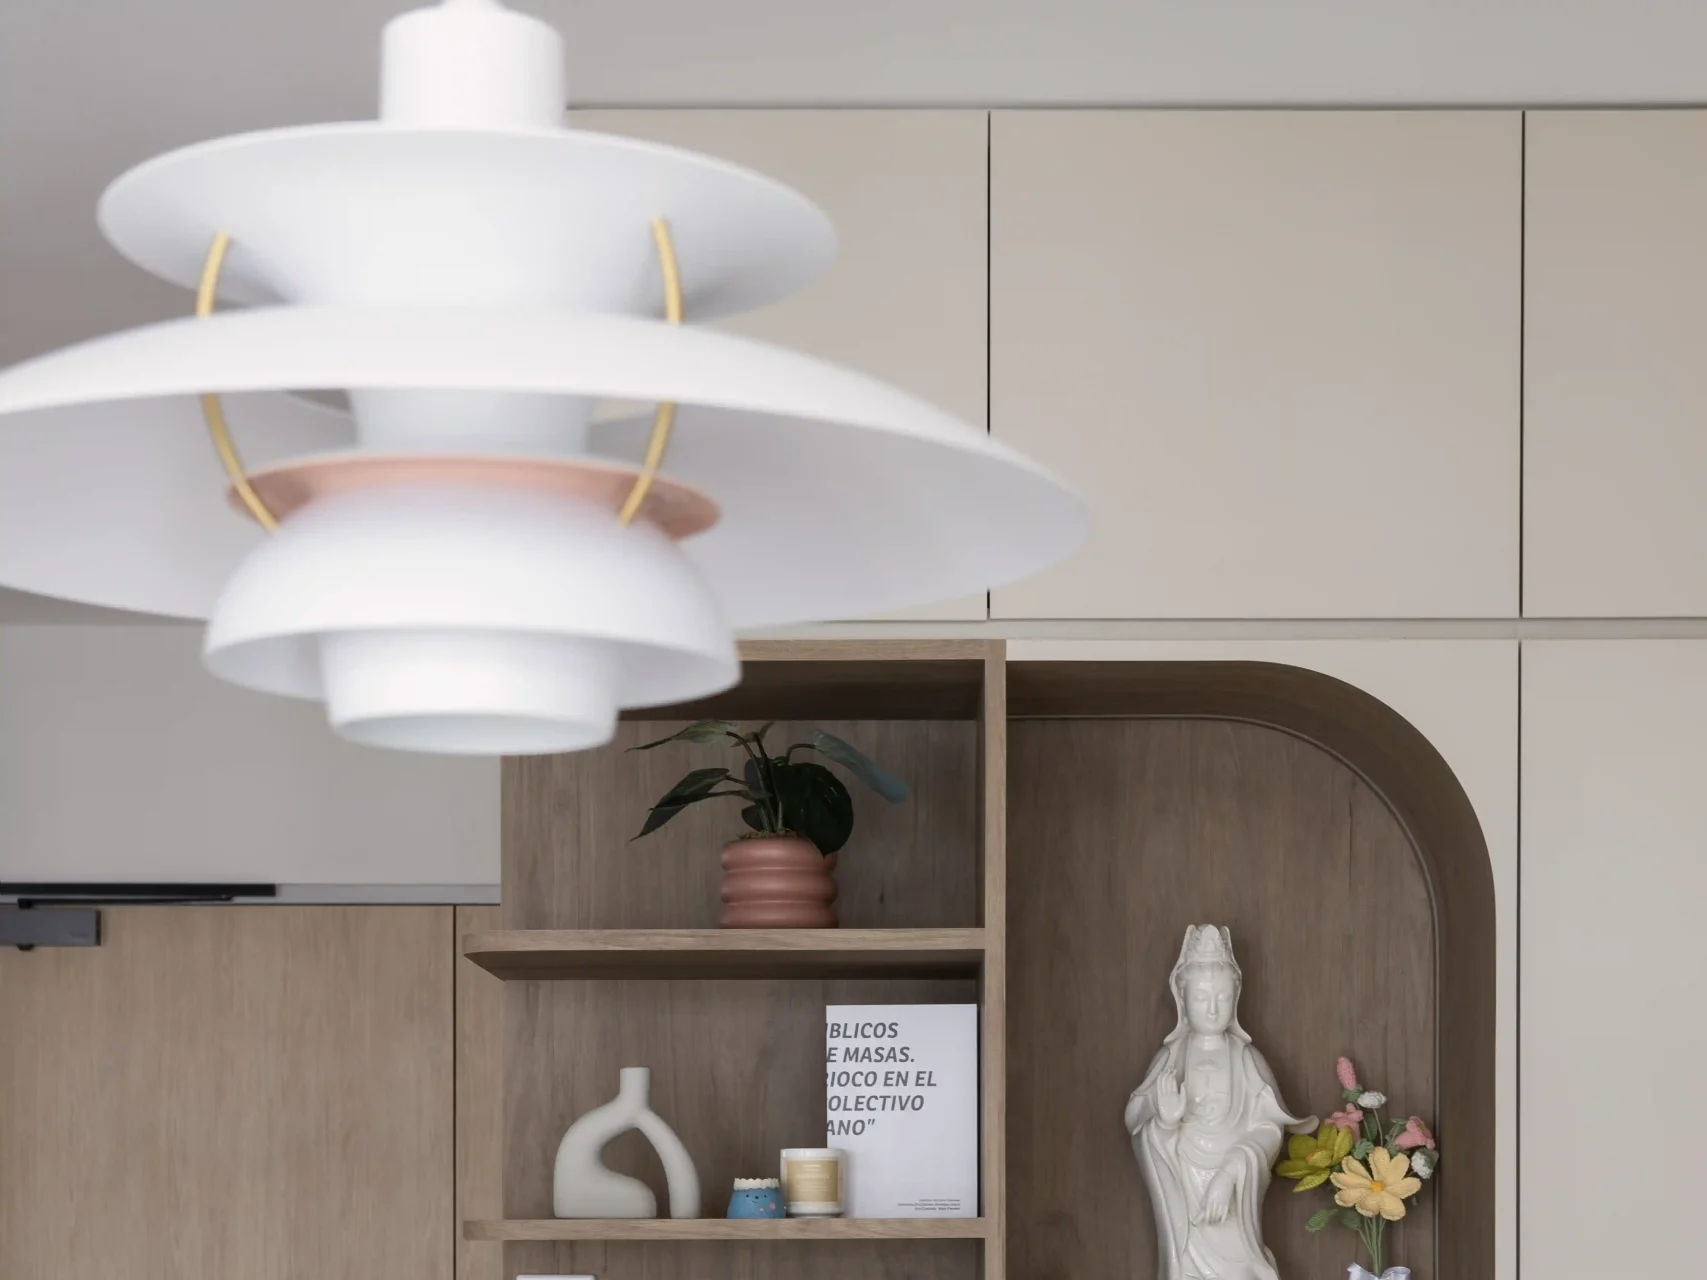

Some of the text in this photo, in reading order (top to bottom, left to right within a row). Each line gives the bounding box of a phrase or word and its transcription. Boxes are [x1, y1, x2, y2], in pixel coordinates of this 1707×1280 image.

[826, 1022, 899, 1039] BLICOS
[843, 1046, 915, 1063] MASAS.
[883, 1071, 909, 1087] EN
[915, 1071, 937, 1087] EL
[826, 1095, 925, 1111] OLECTIVO
